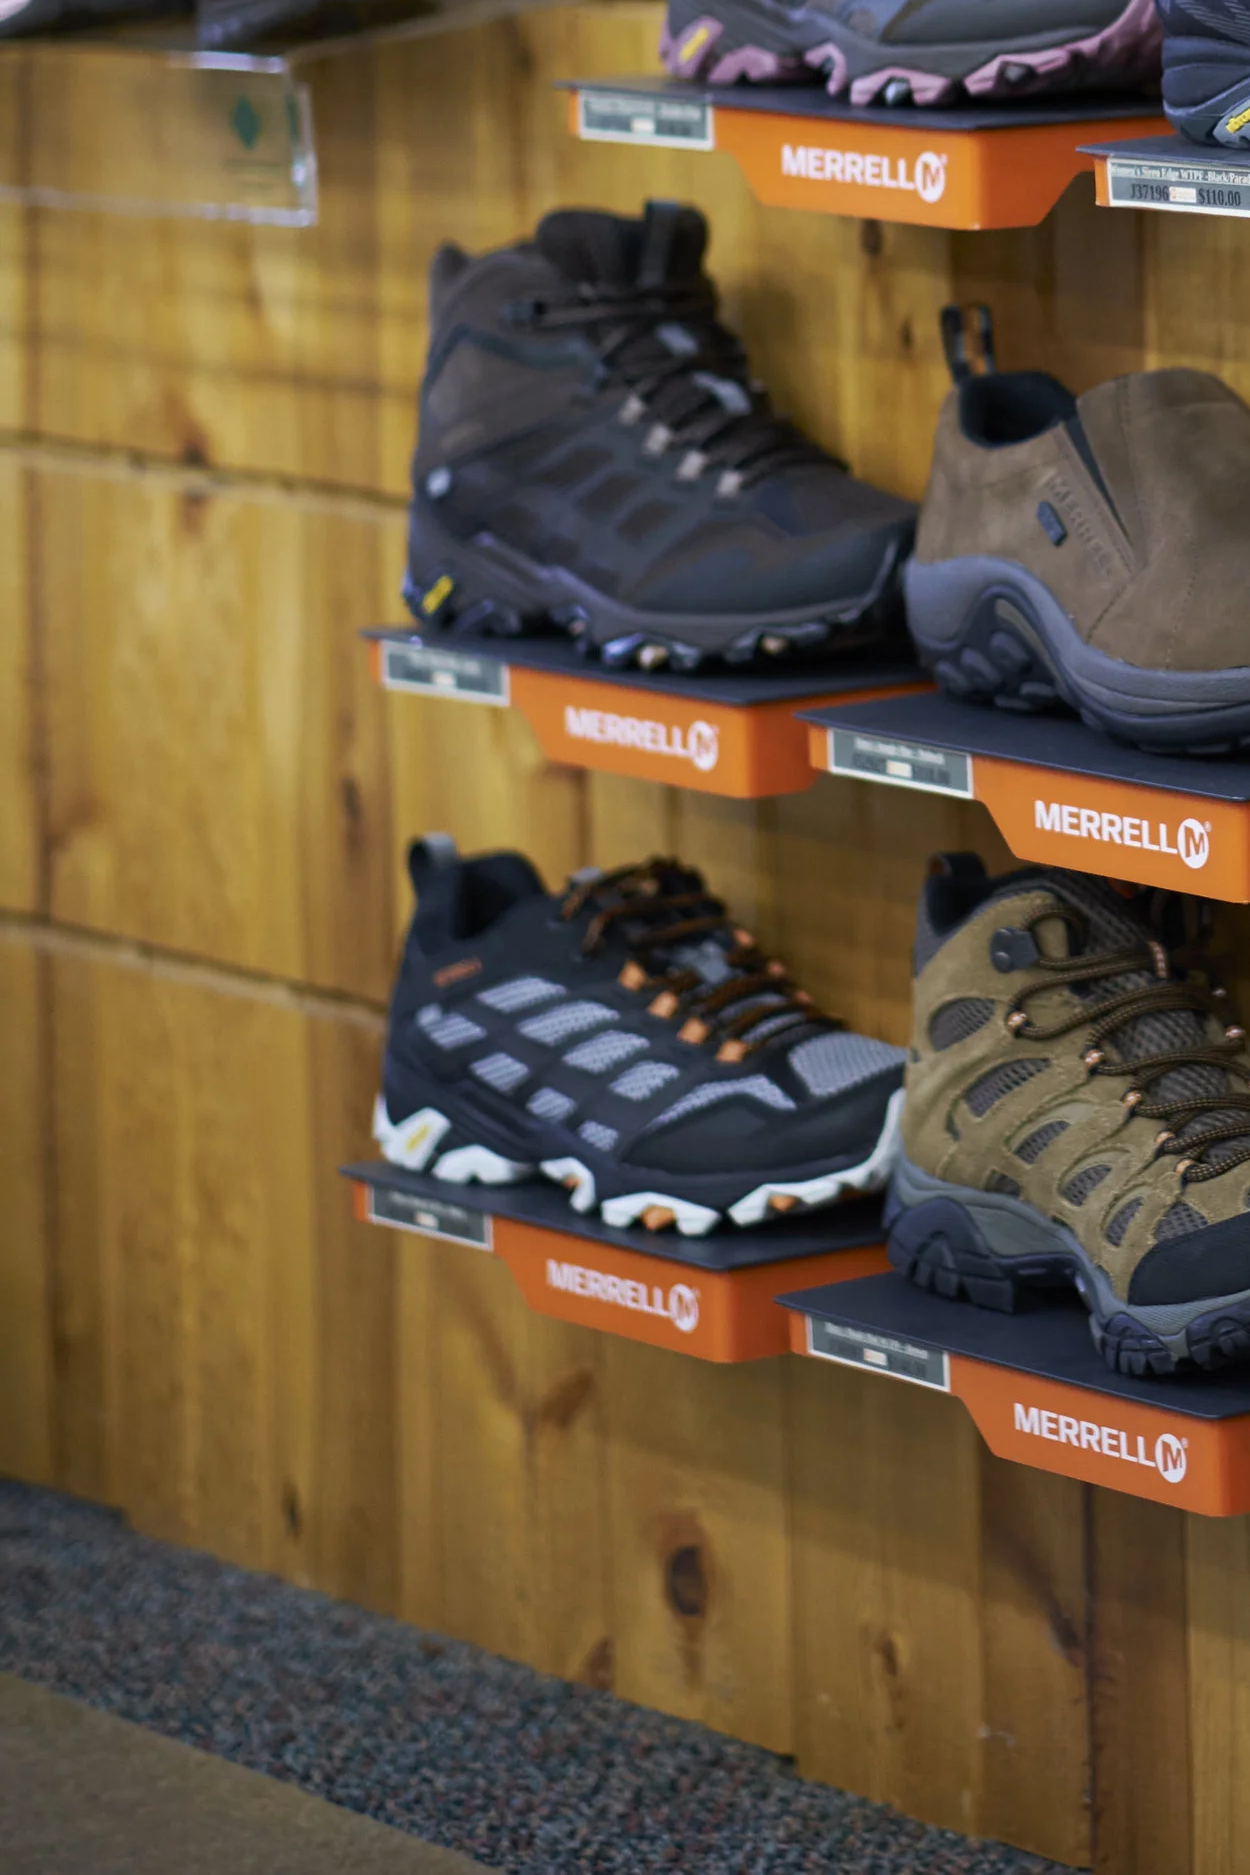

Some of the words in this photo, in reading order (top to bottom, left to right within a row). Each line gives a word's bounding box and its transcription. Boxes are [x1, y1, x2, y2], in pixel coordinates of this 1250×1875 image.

[781, 144, 915, 191] MERRELL
[1130, 184, 1169, 202] J37196
[1198, 189, 1241, 207] $110.00
[565, 705, 691, 758] MERRELL
[1035, 799, 1178, 855] MERRELL
[547, 1259, 670, 1317] MERRELL
[1014, 1402, 1156, 1467] MERRELL
